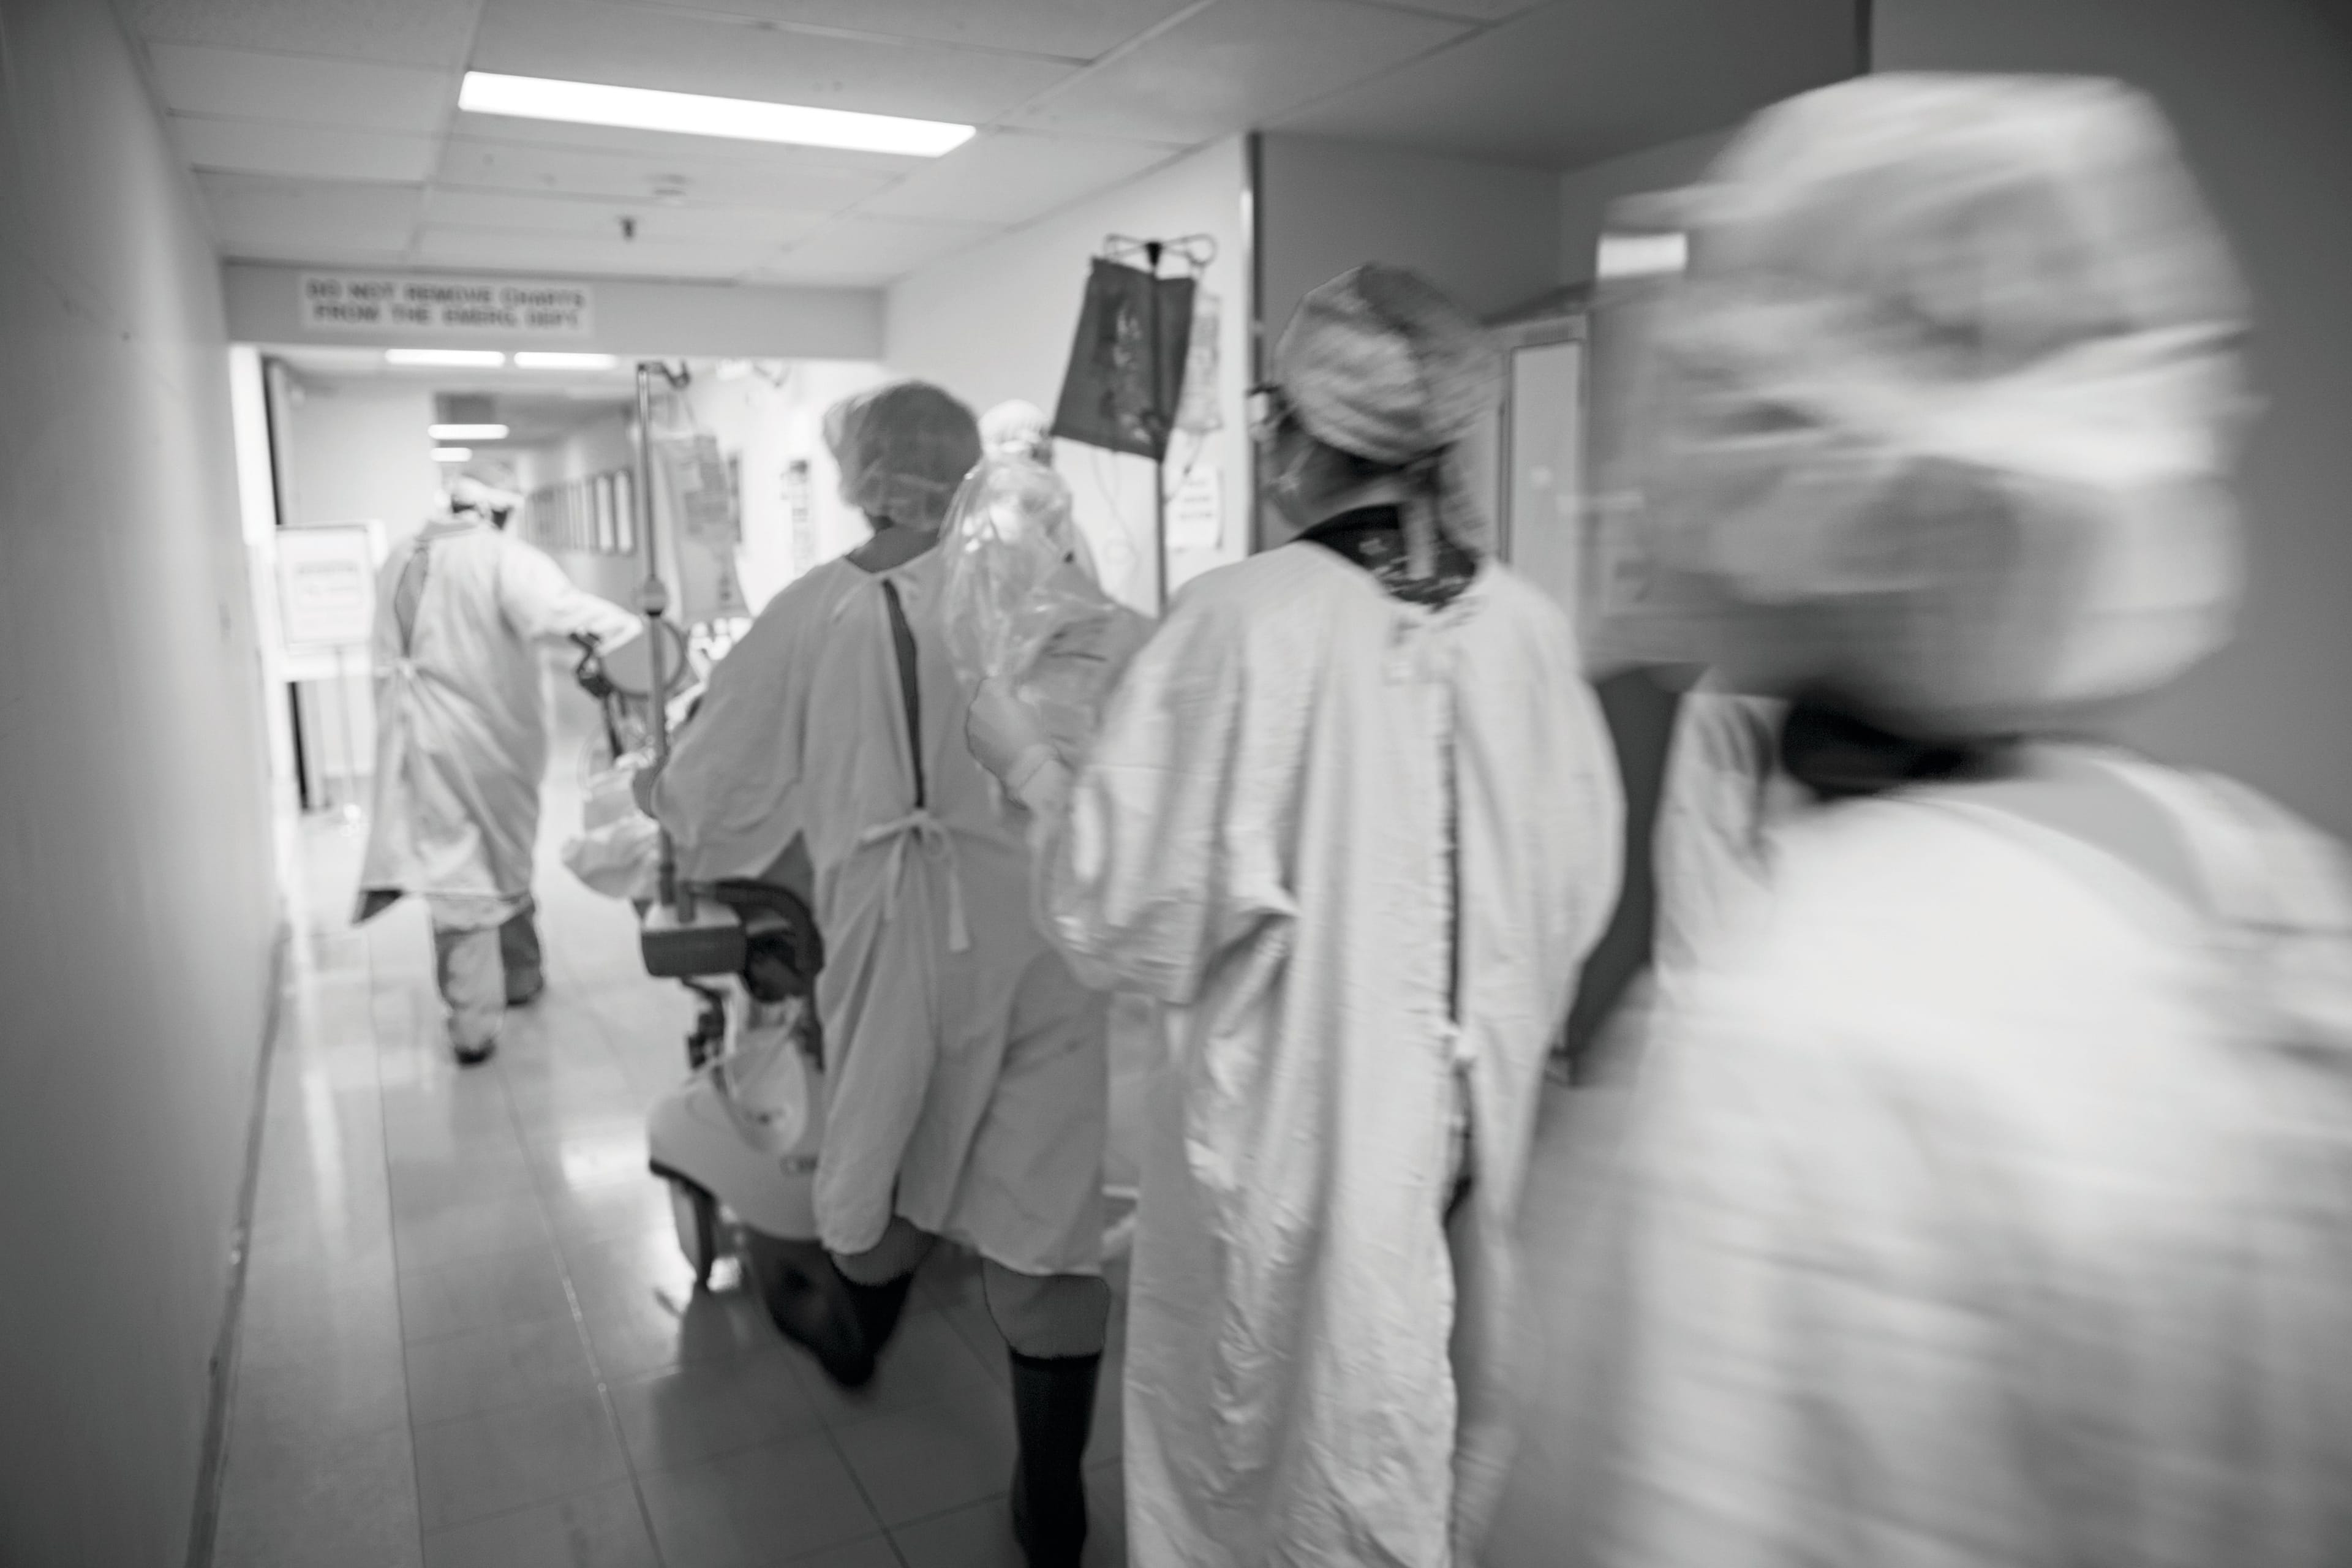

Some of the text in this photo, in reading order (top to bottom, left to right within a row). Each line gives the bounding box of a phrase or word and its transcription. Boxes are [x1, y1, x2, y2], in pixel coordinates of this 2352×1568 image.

[306, 279, 584, 309] DO NOT REMOVE CHARTS
[313, 302, 379, 324] FROM
[391, 303, 431, 325] THE
